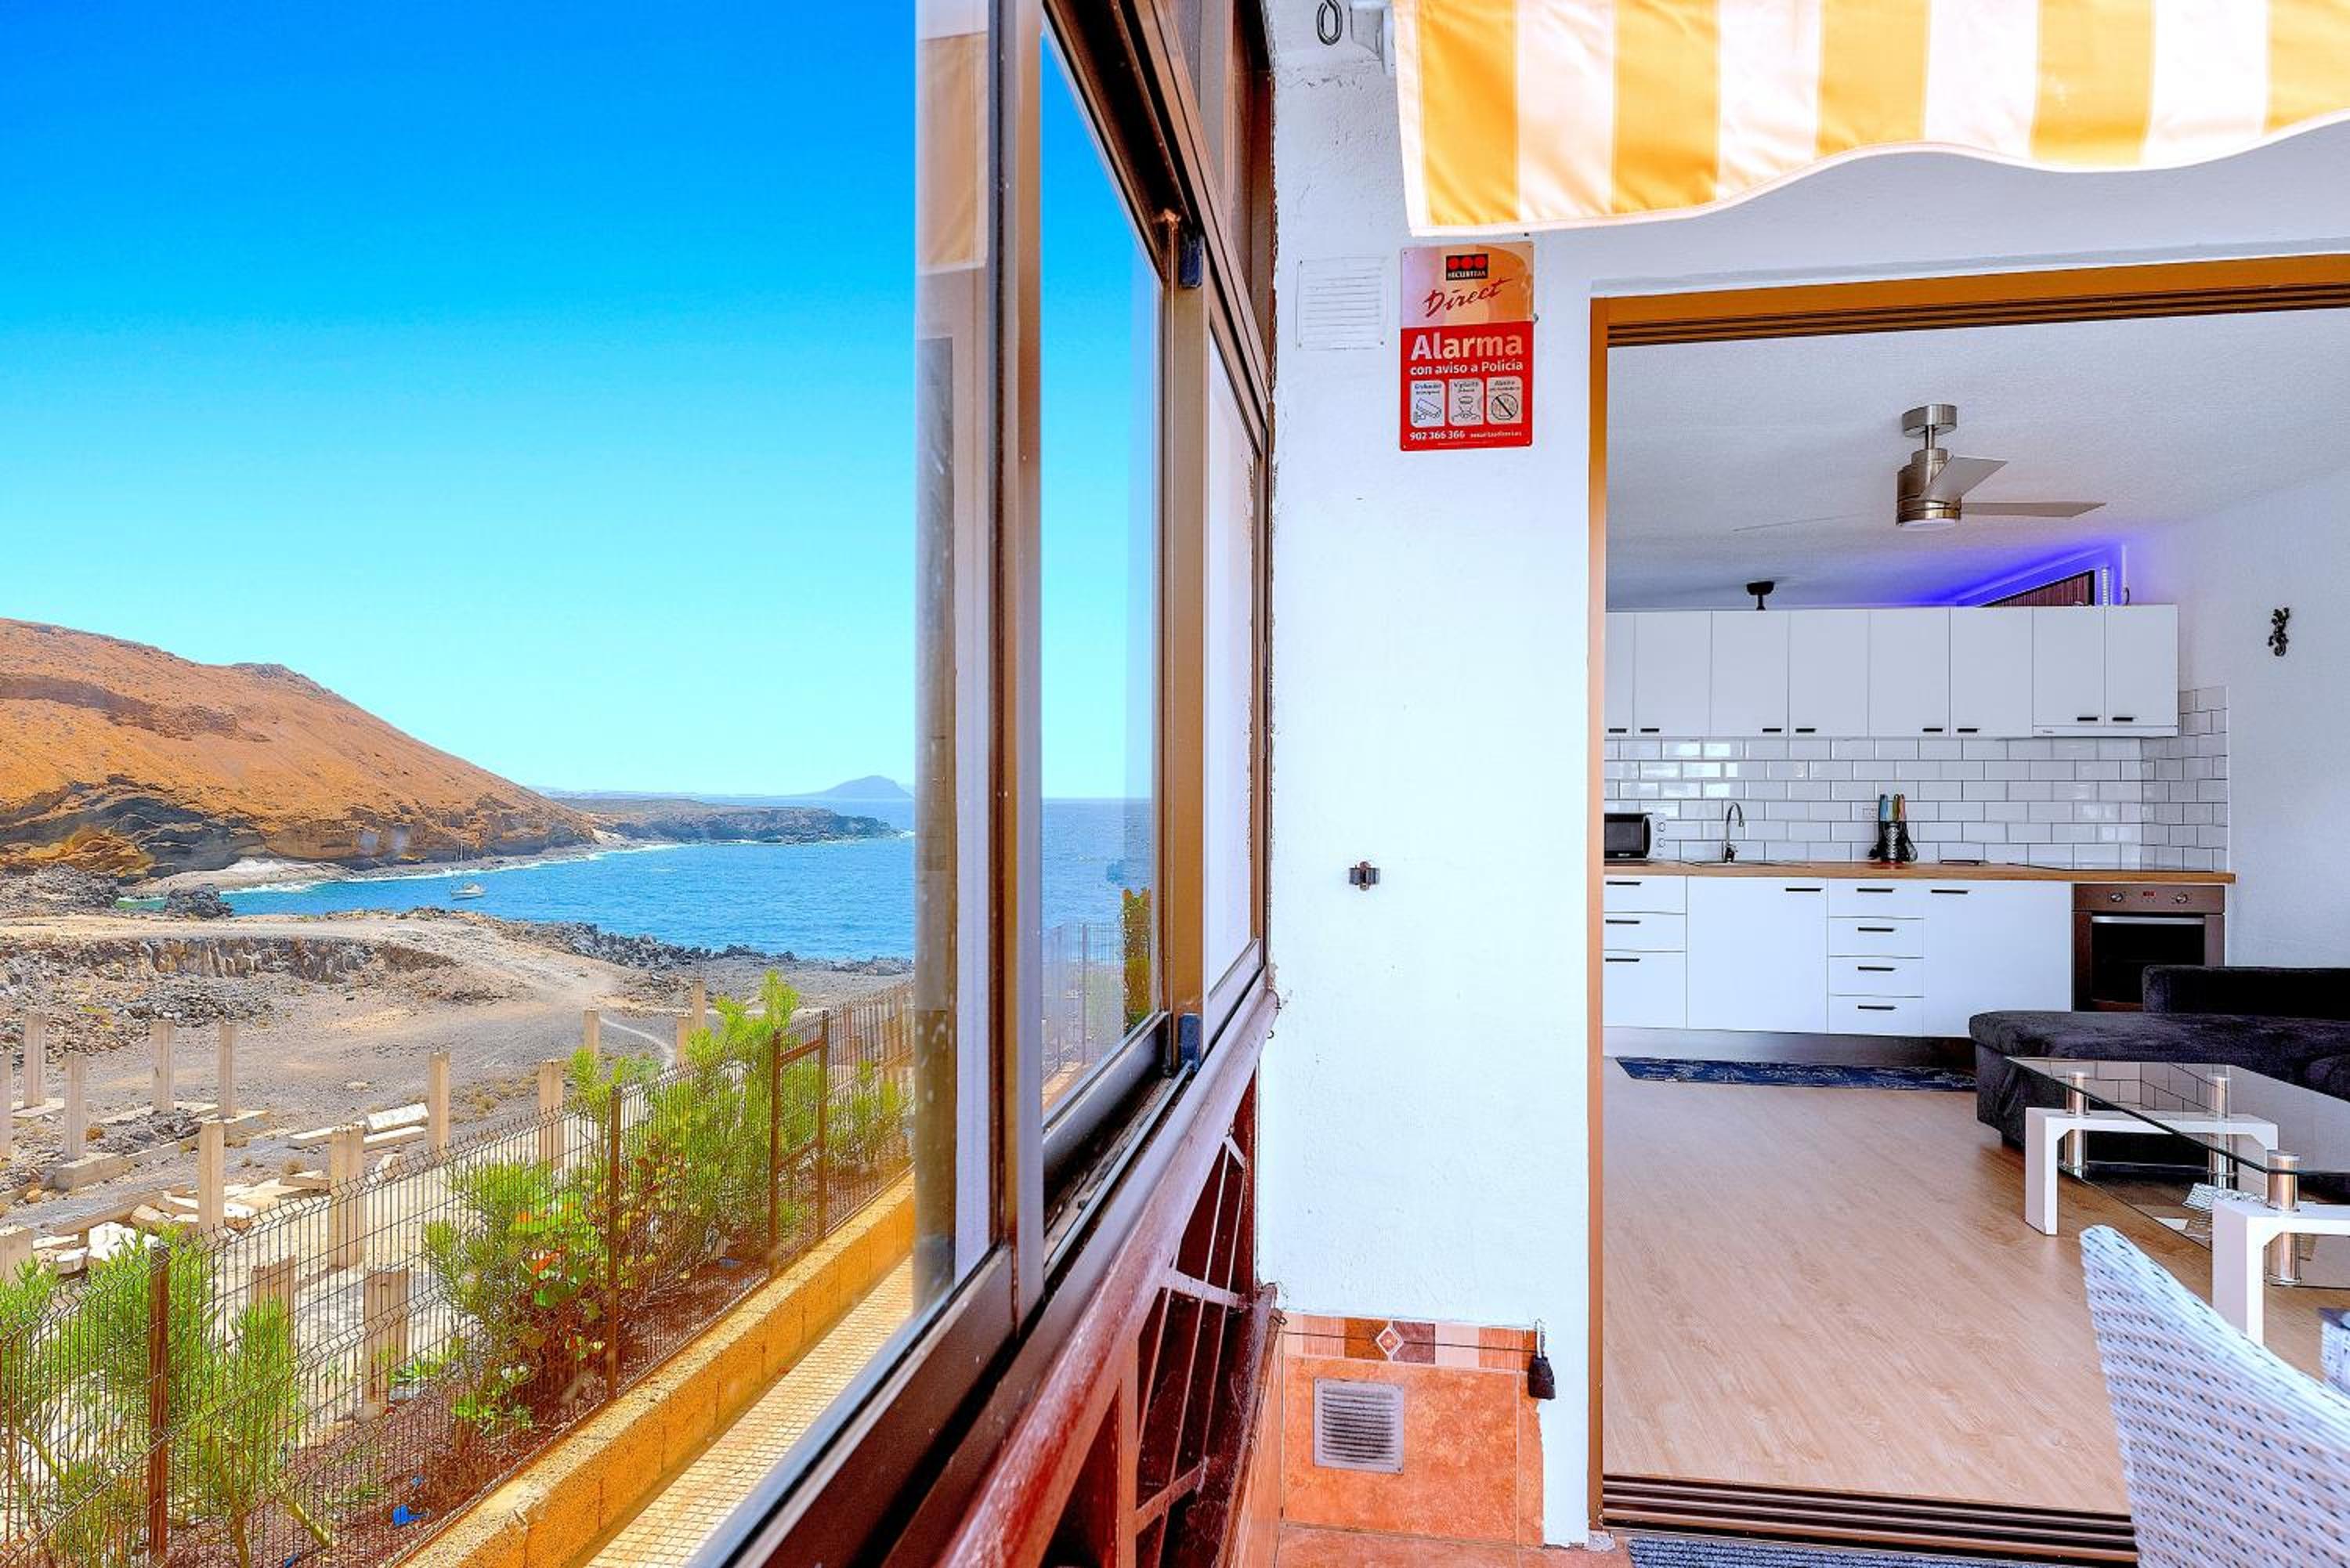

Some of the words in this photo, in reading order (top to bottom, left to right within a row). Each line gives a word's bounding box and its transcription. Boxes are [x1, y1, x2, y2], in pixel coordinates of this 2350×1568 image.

[1422, 277, 1513, 318] Direct
[1411, 331, 1524, 361] Alarma
[1410, 365, 1432, 376] con
[1435, 363, 1468, 374] aviso
[1481, 359, 1524, 372] Policía
